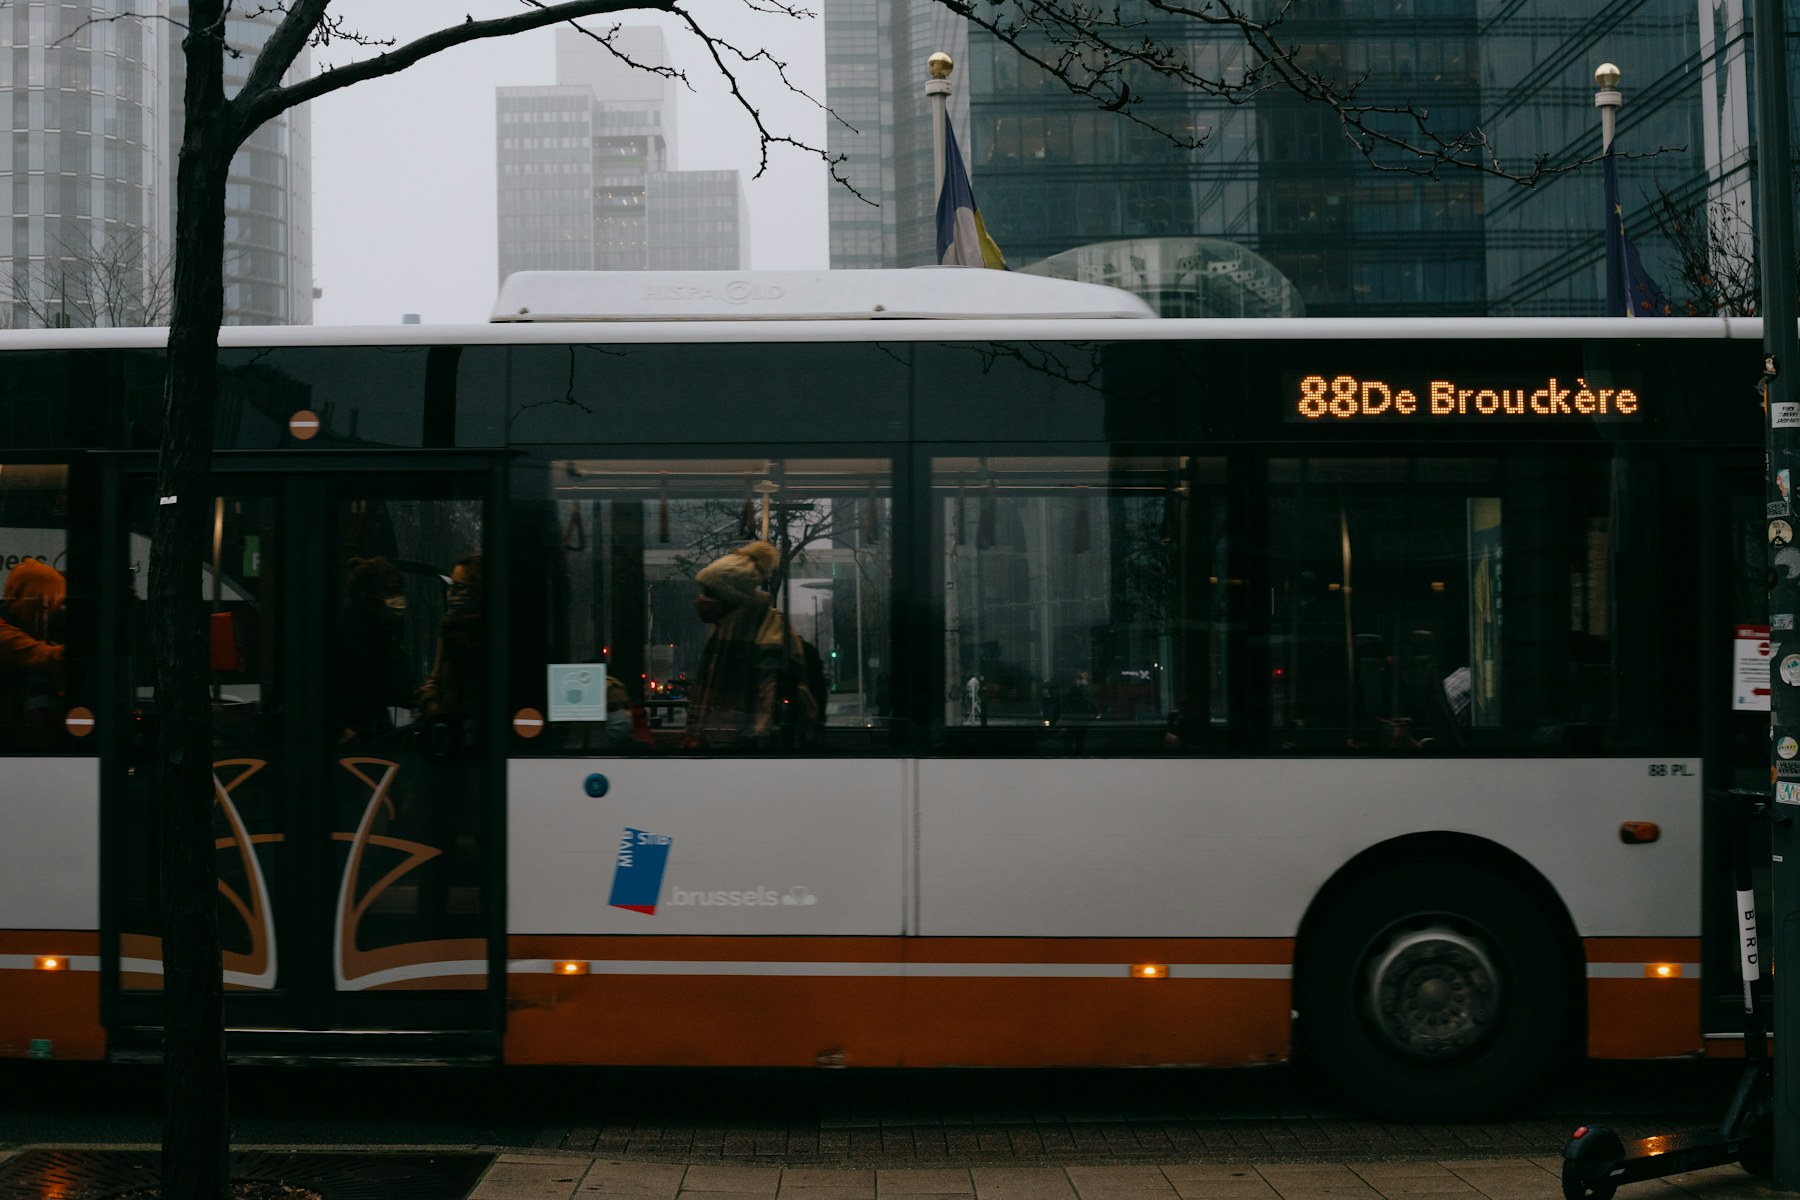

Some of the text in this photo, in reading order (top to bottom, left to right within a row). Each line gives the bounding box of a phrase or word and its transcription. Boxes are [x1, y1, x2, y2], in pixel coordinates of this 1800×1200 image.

[1298, 375, 1638, 418] 88 De Brouckère
[1647, 763, 1669, 777] 88
[616, 830, 634, 868] MIVB
[1744, 909, 1759, 965] BIRD
